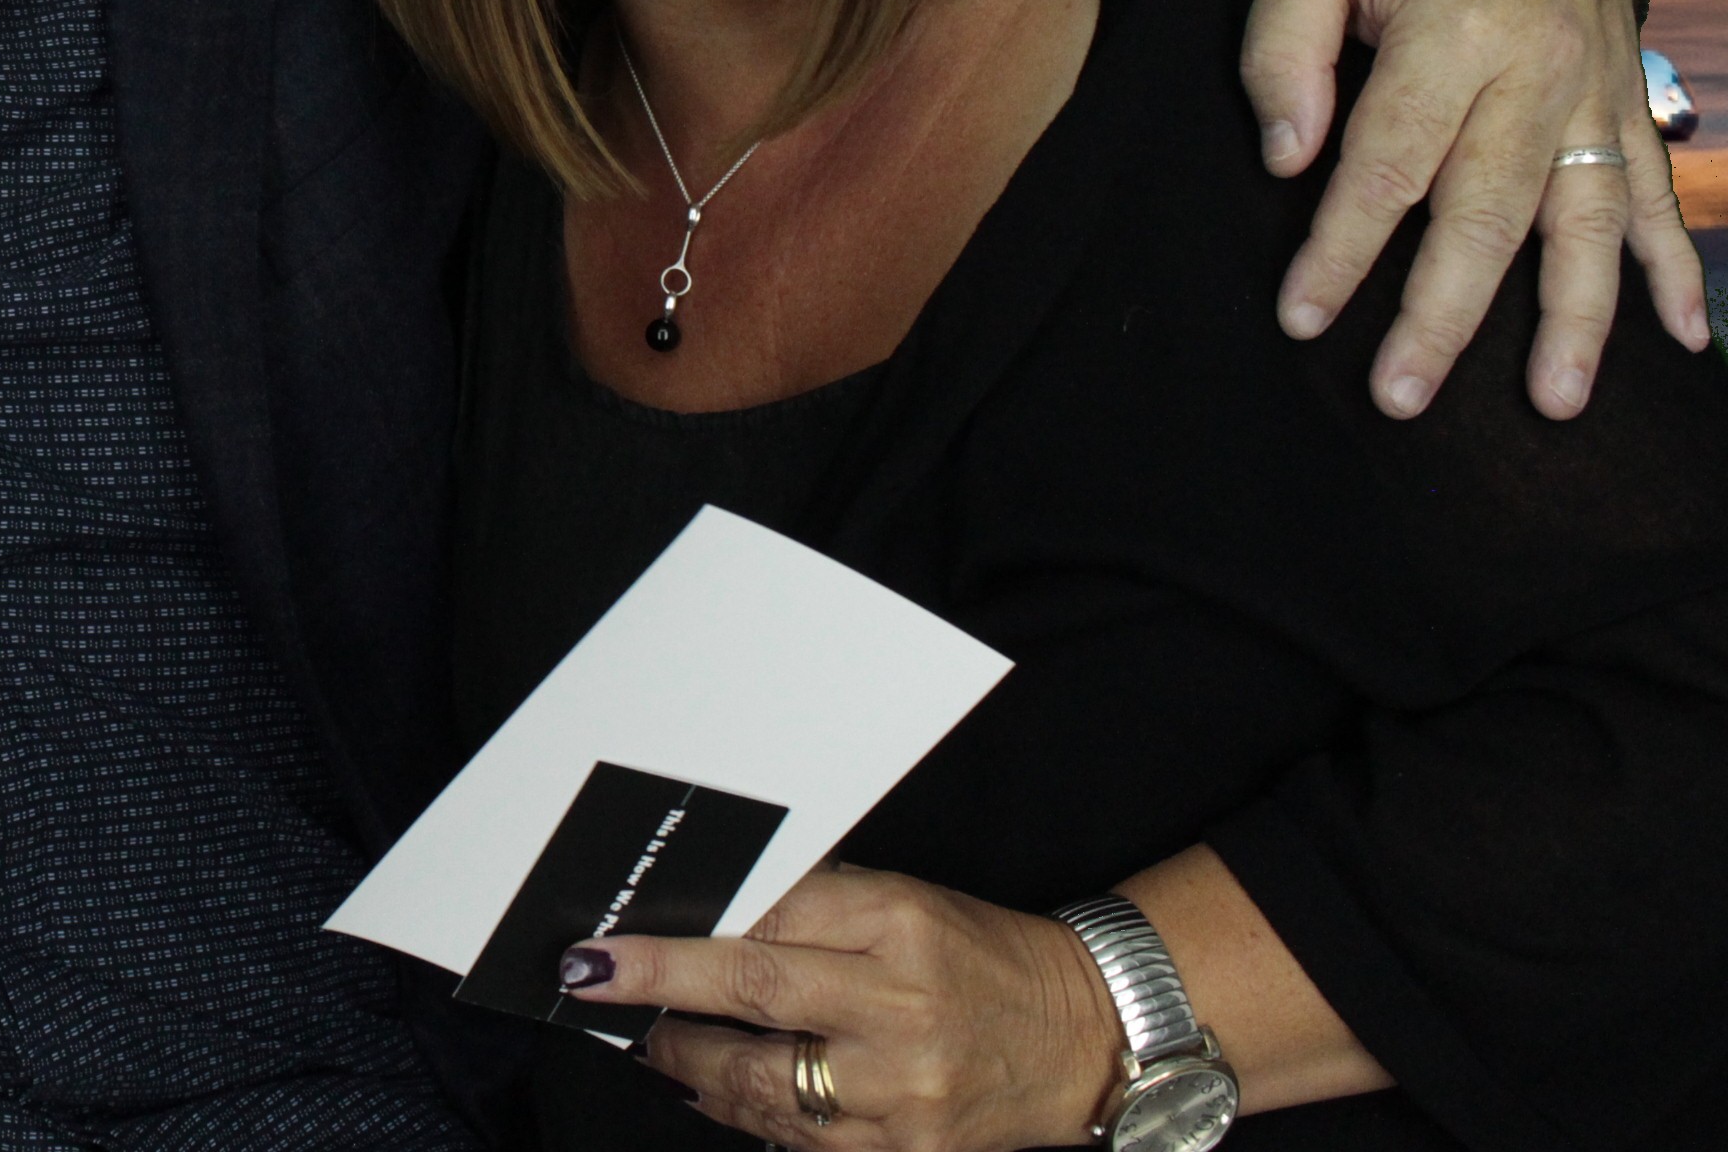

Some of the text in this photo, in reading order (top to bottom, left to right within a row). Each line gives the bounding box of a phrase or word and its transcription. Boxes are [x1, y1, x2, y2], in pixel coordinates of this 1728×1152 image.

[655, 808, 686, 837] This
[646, 839, 666, 853] Is
[626, 855, 656, 886] How
[609, 889, 635, 912] We
